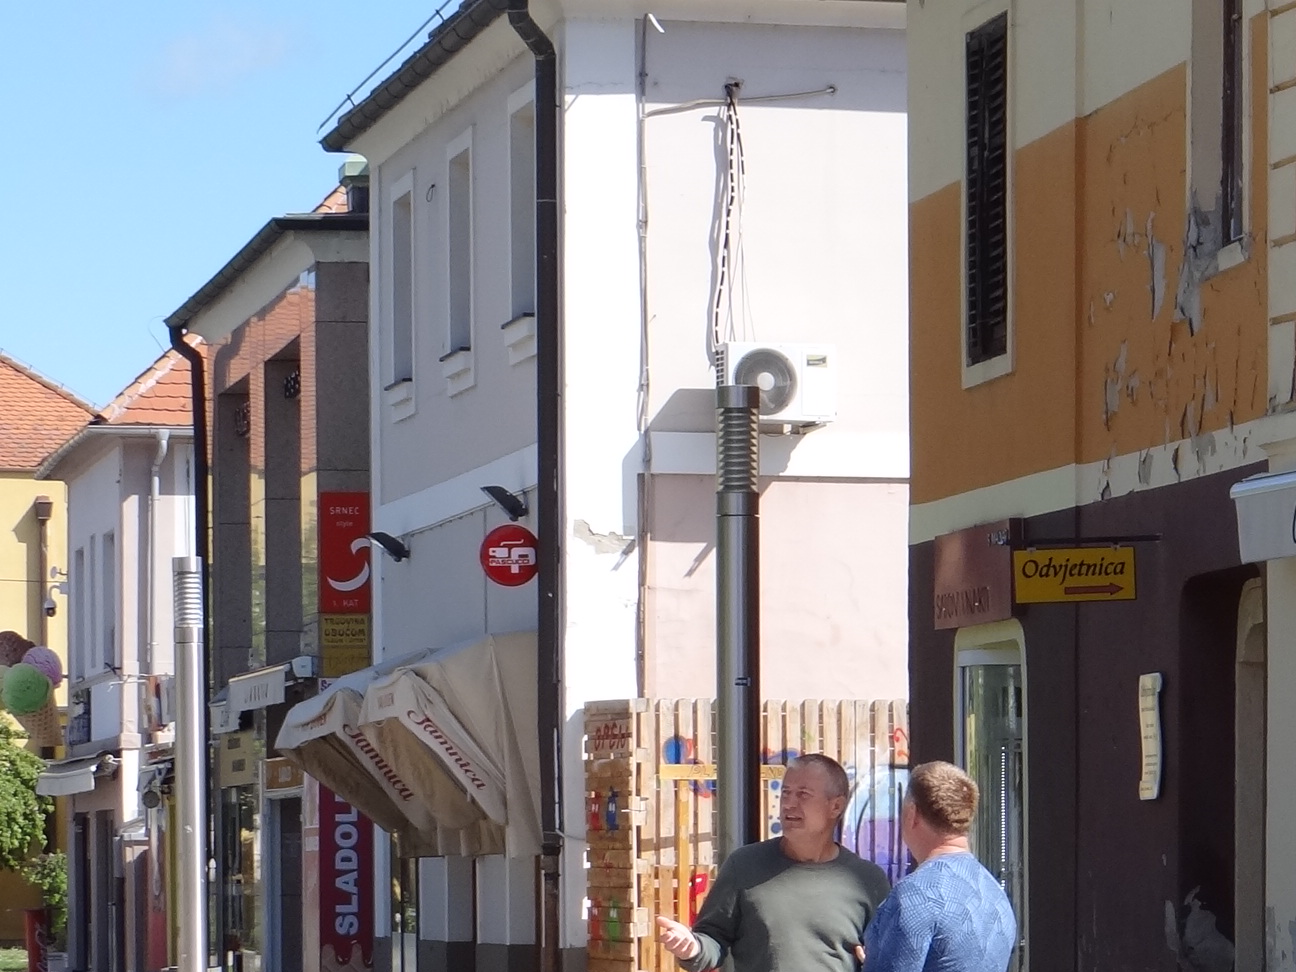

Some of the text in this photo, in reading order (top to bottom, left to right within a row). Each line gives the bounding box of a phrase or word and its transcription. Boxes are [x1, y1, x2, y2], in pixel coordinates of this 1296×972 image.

[329, 506, 360, 515] SRNEC
[1022, 556, 1126, 585] Odvjetnica
[342, 723, 415, 802] Jamnica
[407, 709, 487, 791] Jamnica
